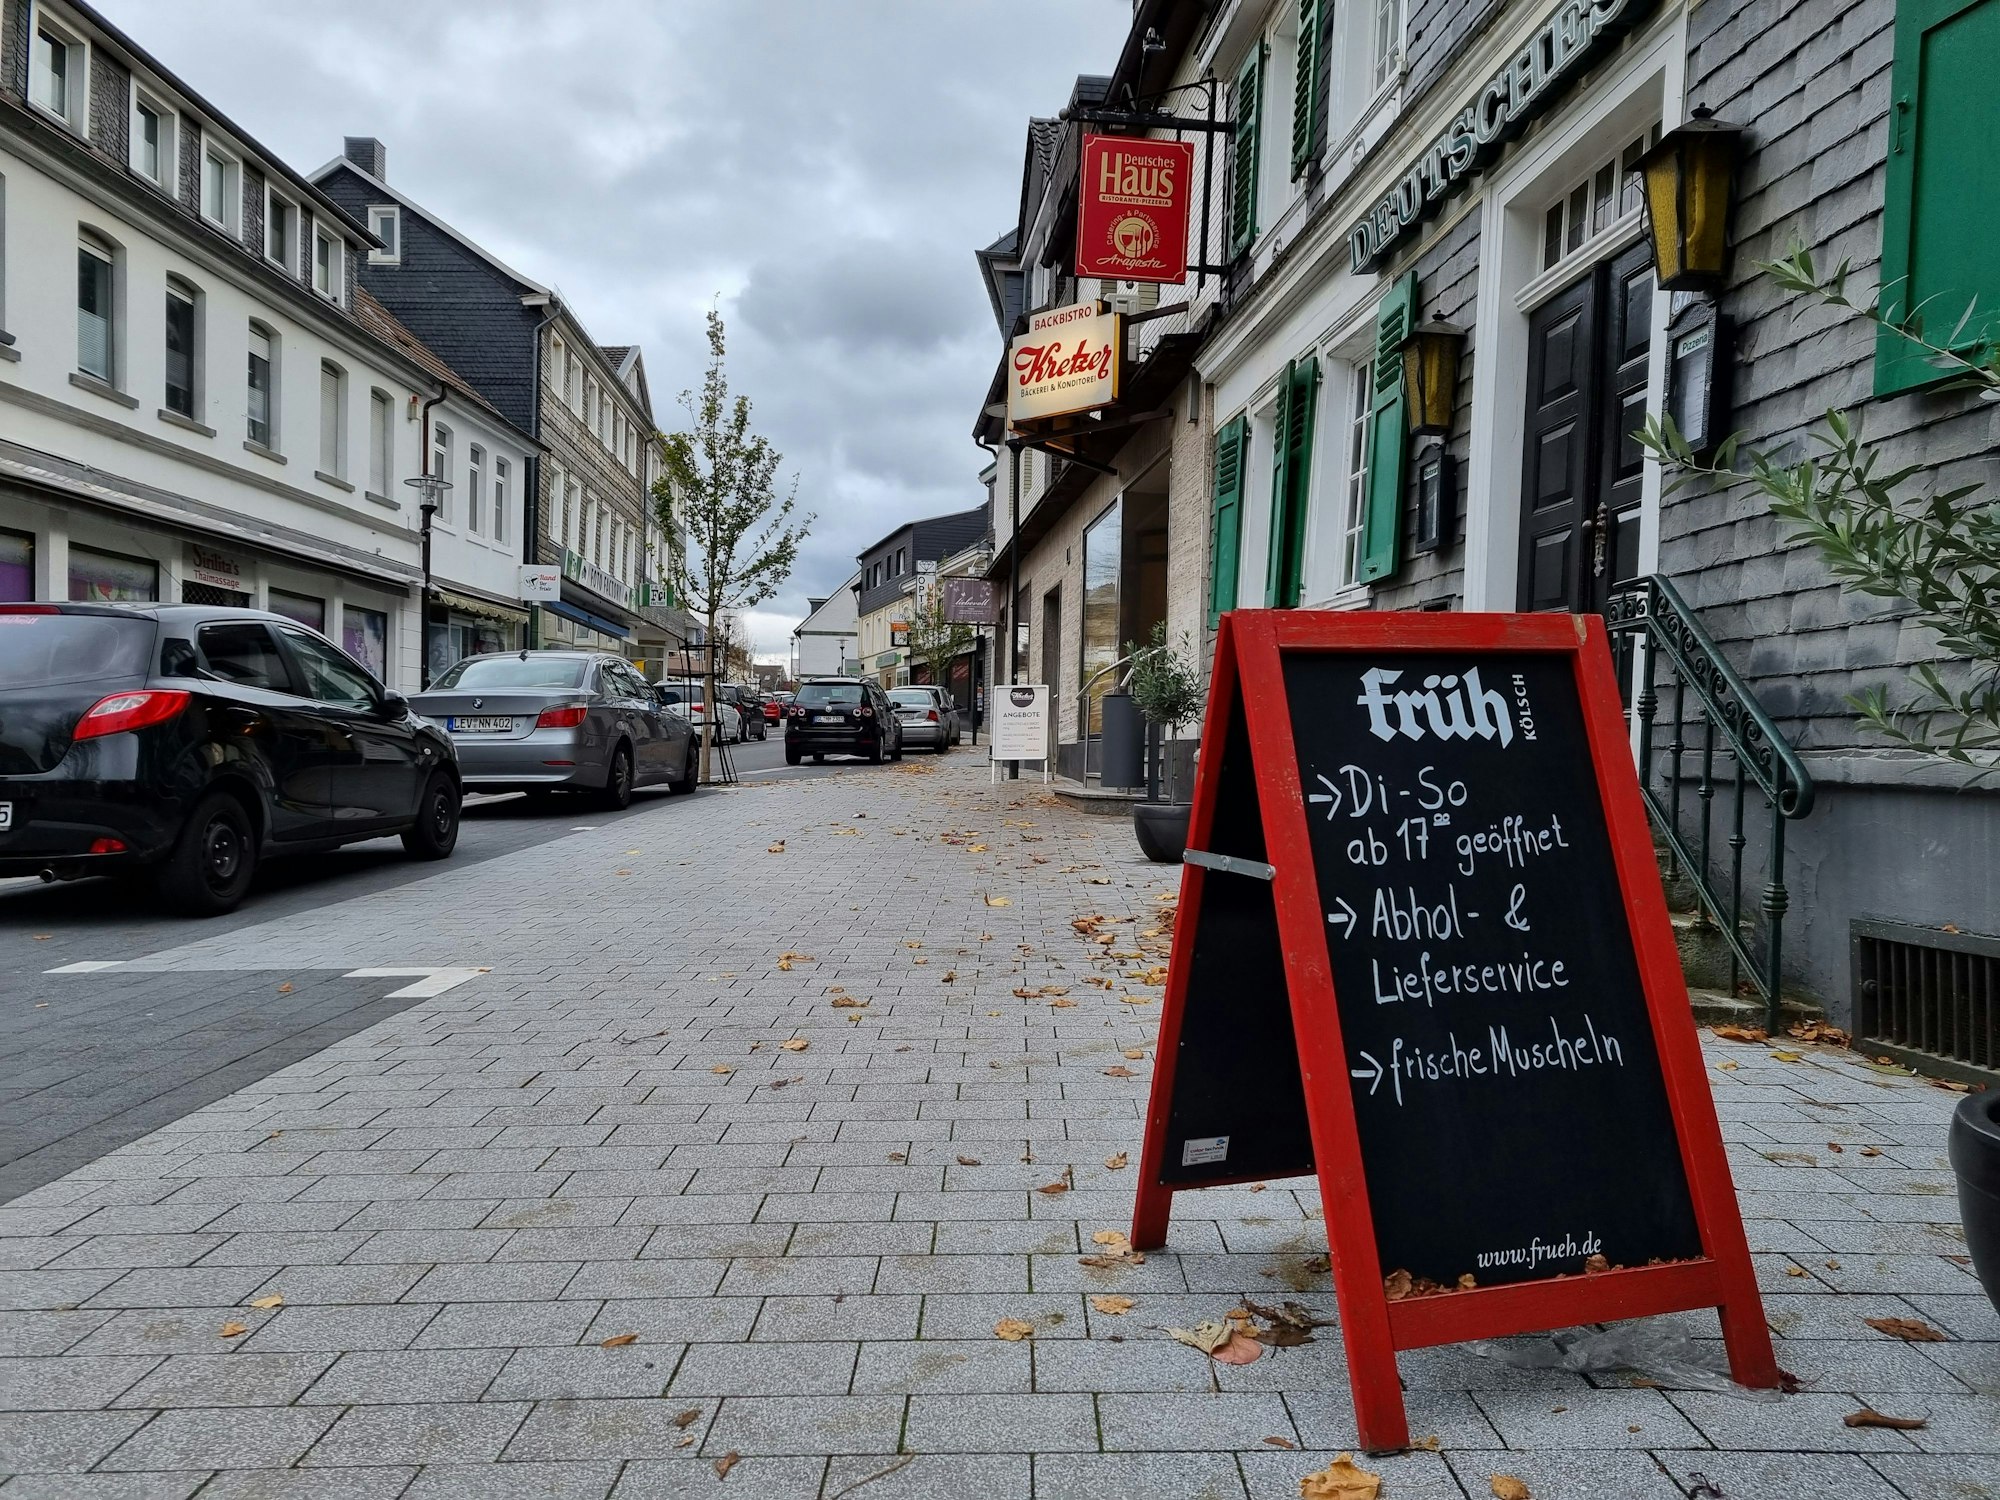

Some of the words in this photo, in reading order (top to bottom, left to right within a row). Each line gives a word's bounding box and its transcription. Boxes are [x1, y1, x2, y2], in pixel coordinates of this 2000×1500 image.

[1099, 151, 1174, 198] Haus
[1124, 153, 1175, 168] Deutsches
[1127, 209, 1133, 218] &
[1134, 209, 1160, 250] Partyservice
[1096, 254, 1167, 271] Aragosta
[1034, 306, 1092, 331] BACKBISTRO
[1014, 338, 1112, 386] Kretzer
[1682, 332, 1708, 354] Pizzeria
[1050, 383, 1057, 393] &
[193, 569, 240, 590] Thaimassage
[454, 718, 473, 729] LEV
[478, 718, 491, 729] NN
[493, 718, 511, 729] 402
[1002, 711, 1041, 719] ANGEBOTE
[1512, 673, 1538, 741] KÖLSCH
[1346, 826, 1389, 866] ab
[1456, 813, 1569, 877] geöffnet
[1372, 882, 1479, 941] Abhol-
[1504, 883, 1531, 932] &
[1372, 951, 1570, 1008] Lieferservice
[1389, 1031, 1488, 1107] frische
[1488, 1013, 1624, 1079] Muscheln
[1476, 1230, 1603, 1271] www.frueh.de
